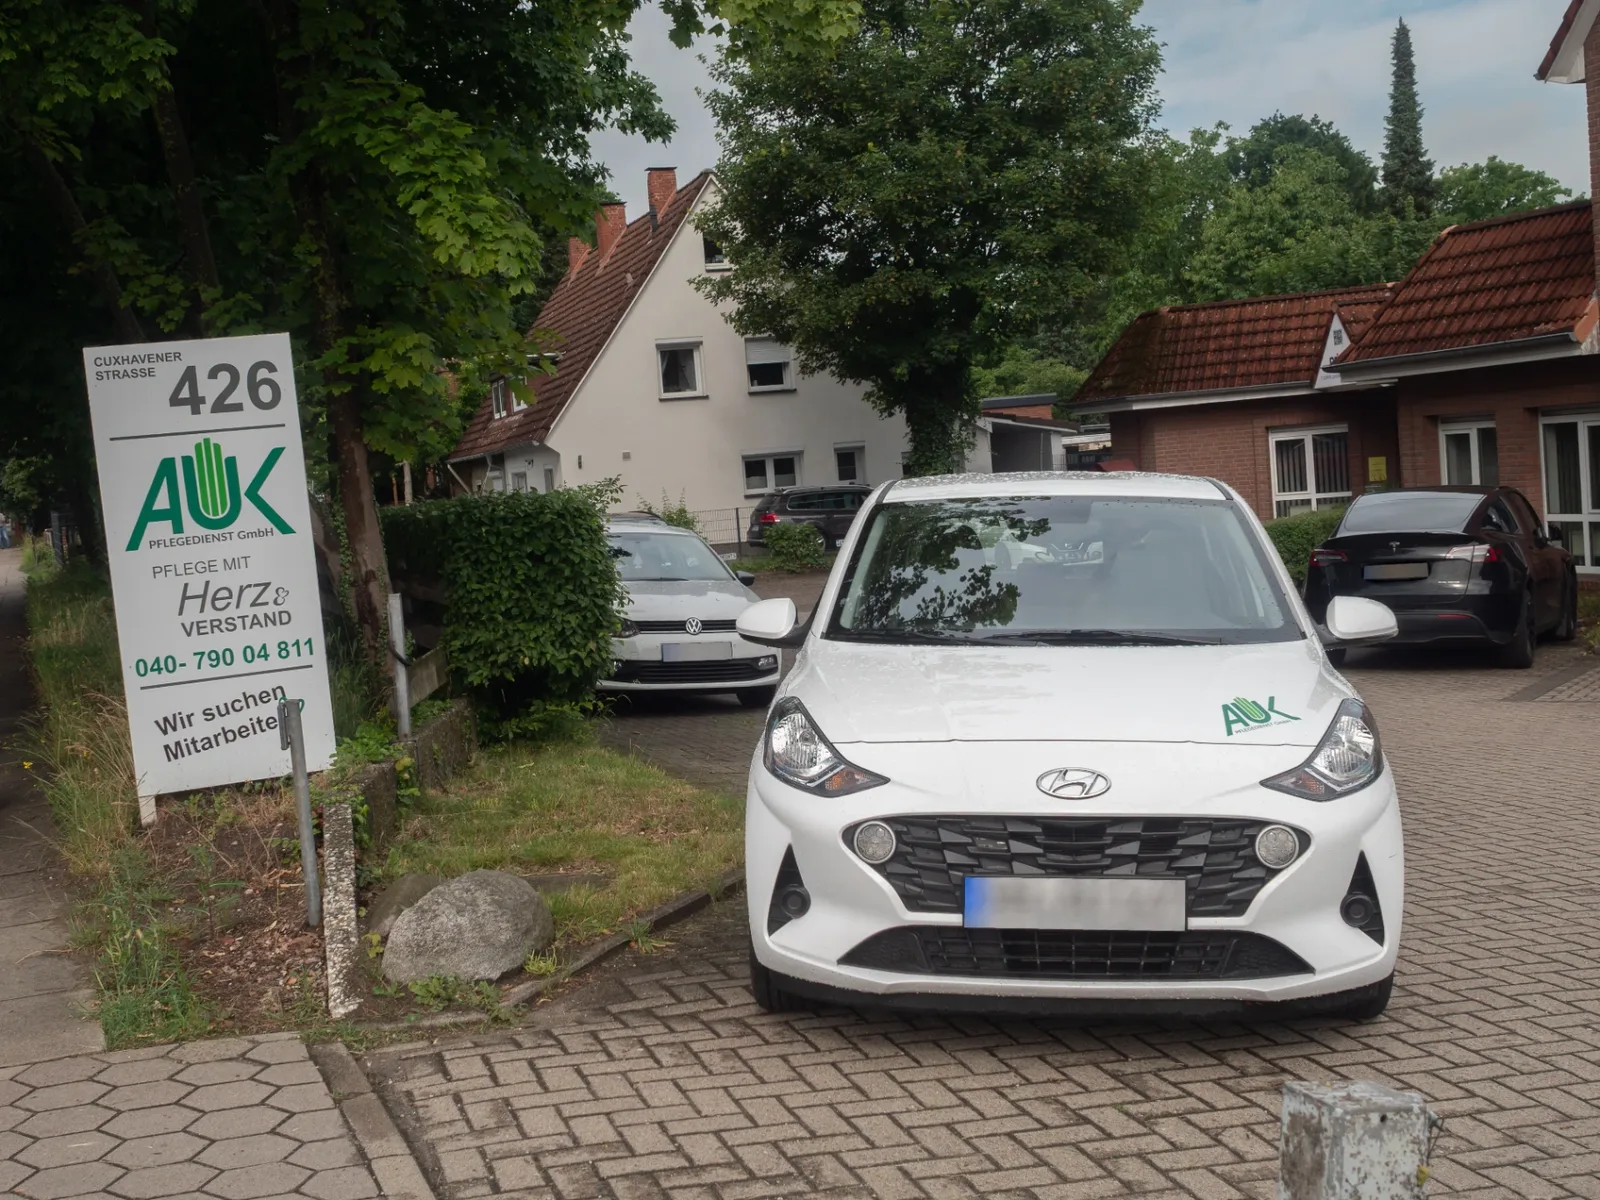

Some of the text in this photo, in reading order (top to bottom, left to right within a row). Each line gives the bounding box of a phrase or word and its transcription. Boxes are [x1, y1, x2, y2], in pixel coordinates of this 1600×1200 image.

[94, 352, 182, 367] CUXHAVENER
[95, 368, 156, 381] STRASSE
[169, 360, 281, 415] 426
[126, 438, 297, 551] AUK
[149, 528, 274, 549] PFLEGEDIENST GmbH
[152, 556, 251, 578] PFLEGE MIT
[178, 581, 272, 616] Herz
[181, 610, 292, 637] VERSTAND
[135, 638, 314, 677] 040- 790 04 811
[154, 685, 287, 736] Wir suchen
[1221, 696, 1302, 736] AUK
[163, 715, 280, 762] Mitarbeite
